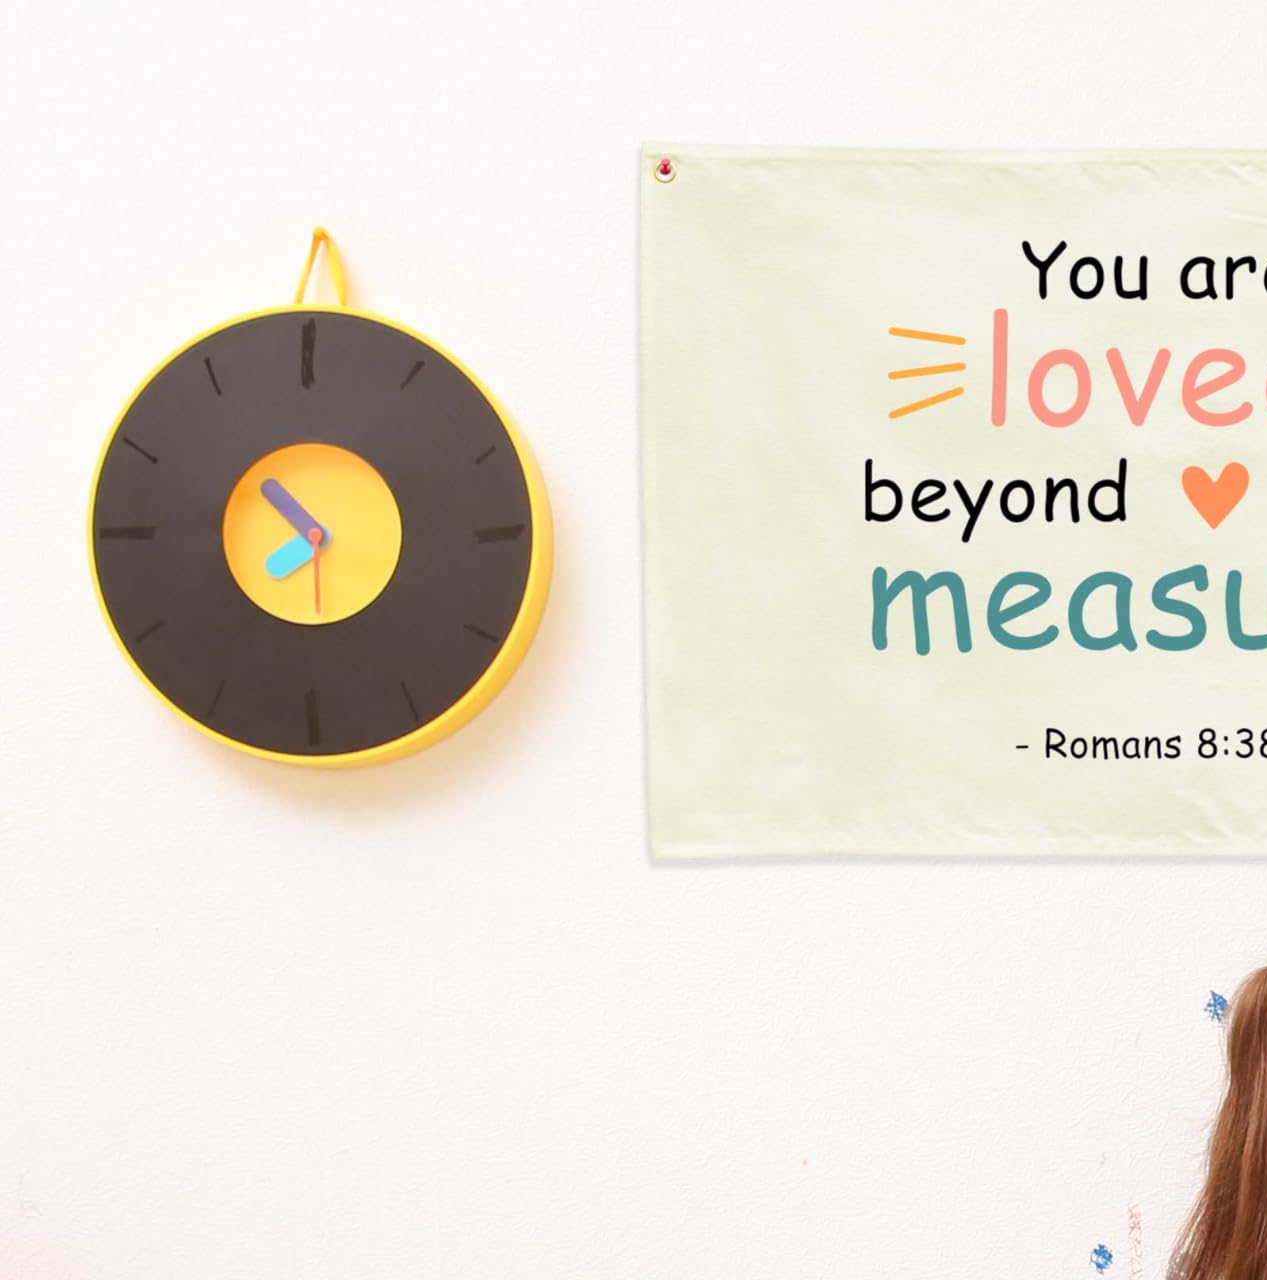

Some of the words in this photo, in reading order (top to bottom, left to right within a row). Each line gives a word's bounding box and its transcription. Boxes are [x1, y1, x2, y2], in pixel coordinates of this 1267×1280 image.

[1021, 239, 1149, 302] You
[863, 456, 1129, 545] beyond
[1043, 726, 1183, 762] Romans
